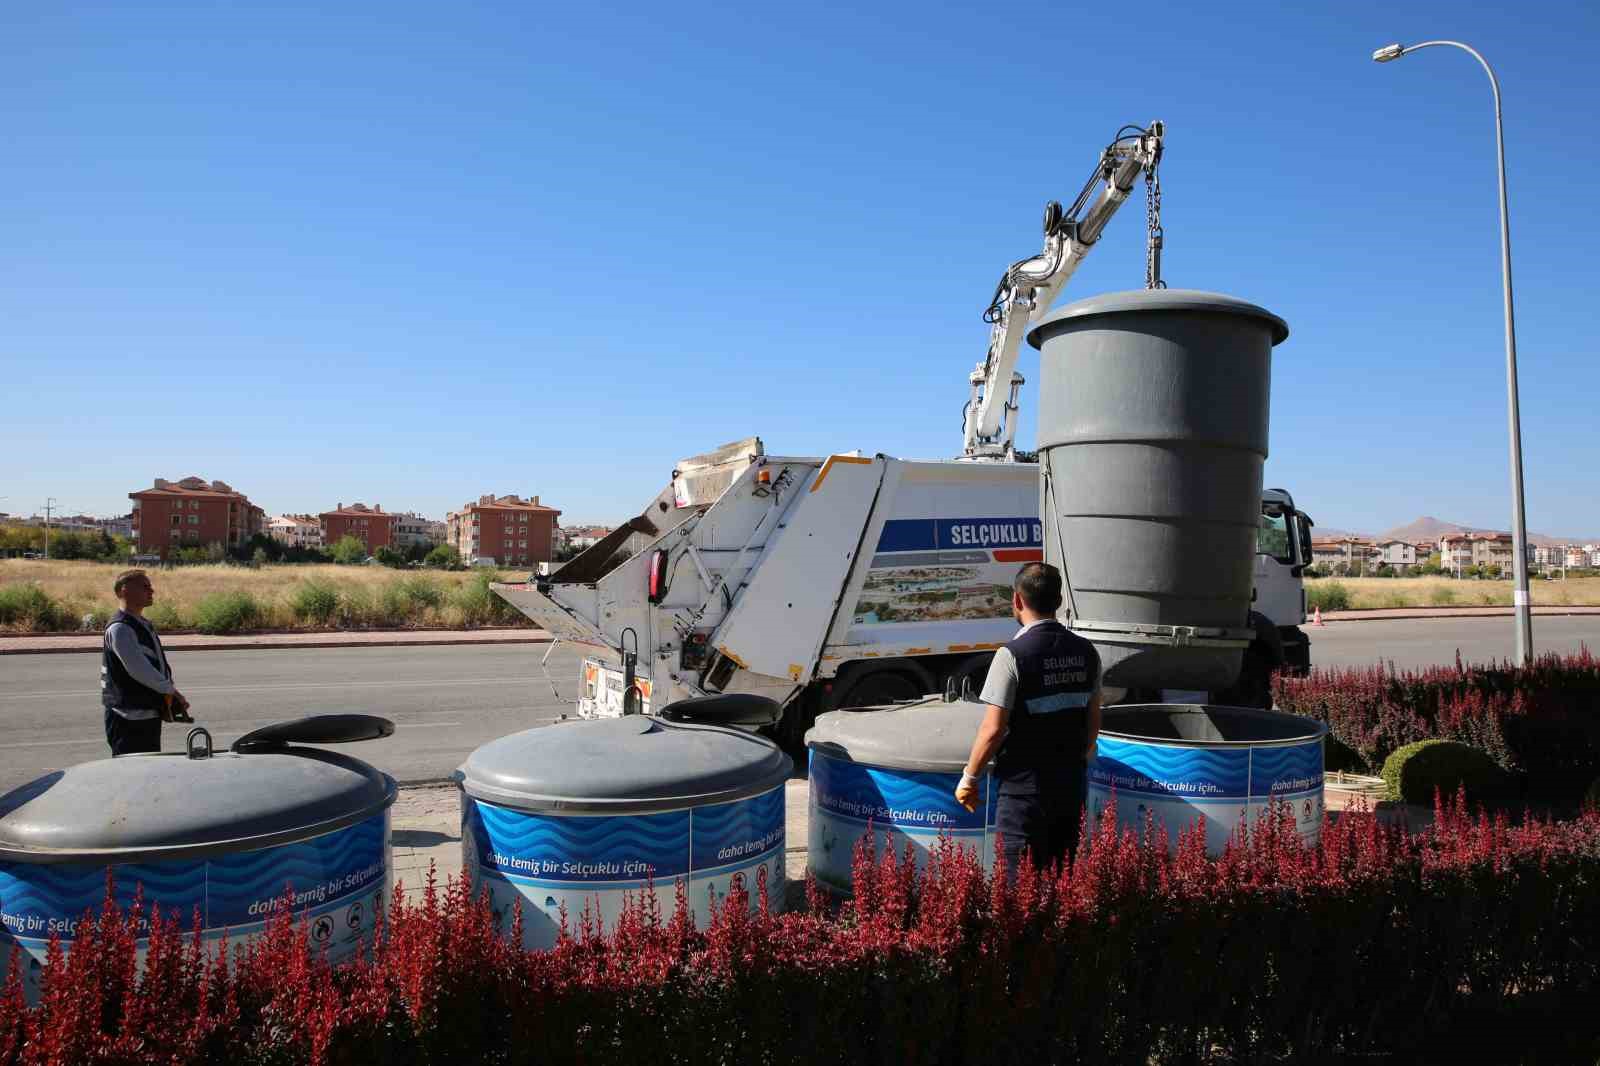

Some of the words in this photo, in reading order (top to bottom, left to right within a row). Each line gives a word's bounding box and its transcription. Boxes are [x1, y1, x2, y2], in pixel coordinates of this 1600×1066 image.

[951, 524, 1028, 547] SELÇUKLU
[877, 806, 924, 822] Selçuklu
[718, 844, 743, 860] daha
[487, 851, 509, 866] daha
[511, 854, 540, 874] temiz
[543, 859, 560, 873] bir
[562, 861, 620, 877] Selçuklu
[328, 878, 344, 895] bir
[27, 915, 46, 931] bir
